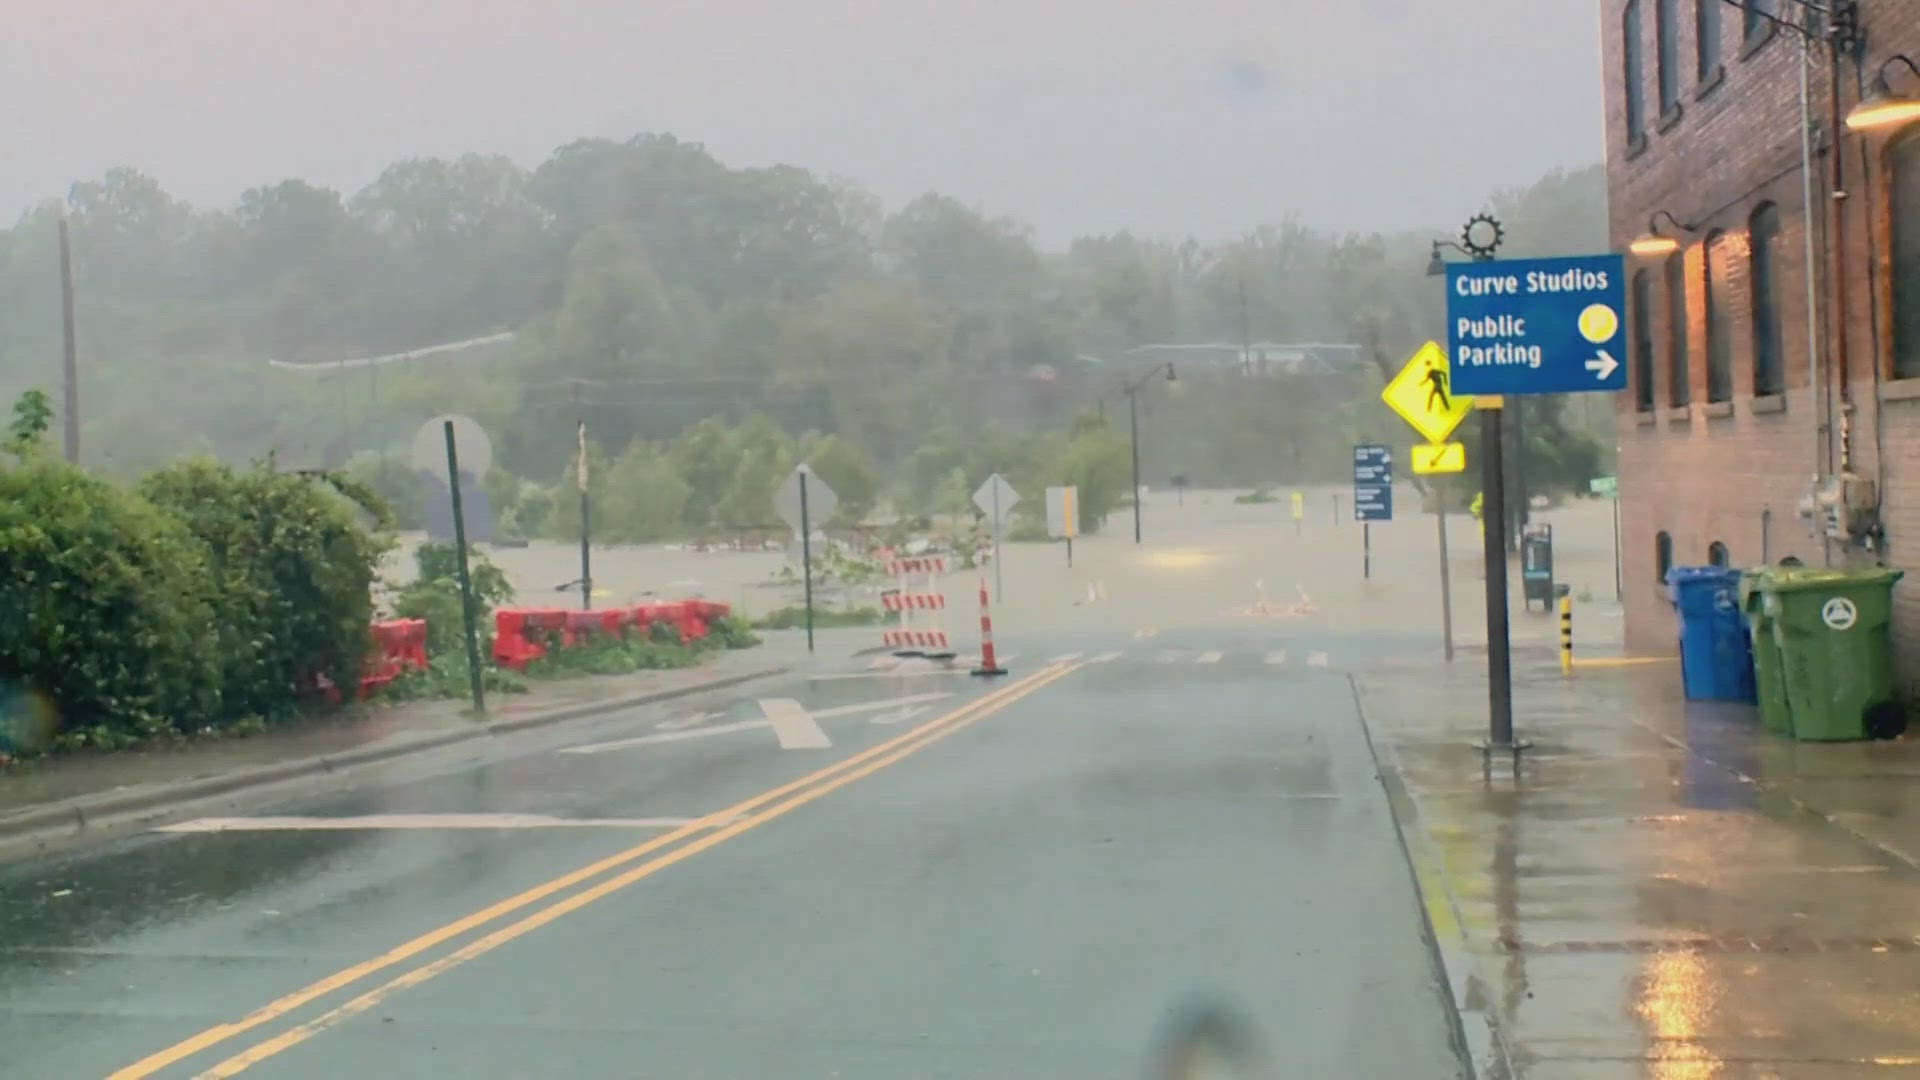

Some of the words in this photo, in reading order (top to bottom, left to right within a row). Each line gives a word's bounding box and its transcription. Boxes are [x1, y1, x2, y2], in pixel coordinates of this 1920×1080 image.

[1456, 275, 1518, 296] Curve
[1526, 268, 1608, 293] Studios
[1457, 314, 1526, 339] Public
[1458, 342, 1541, 368] Parking
